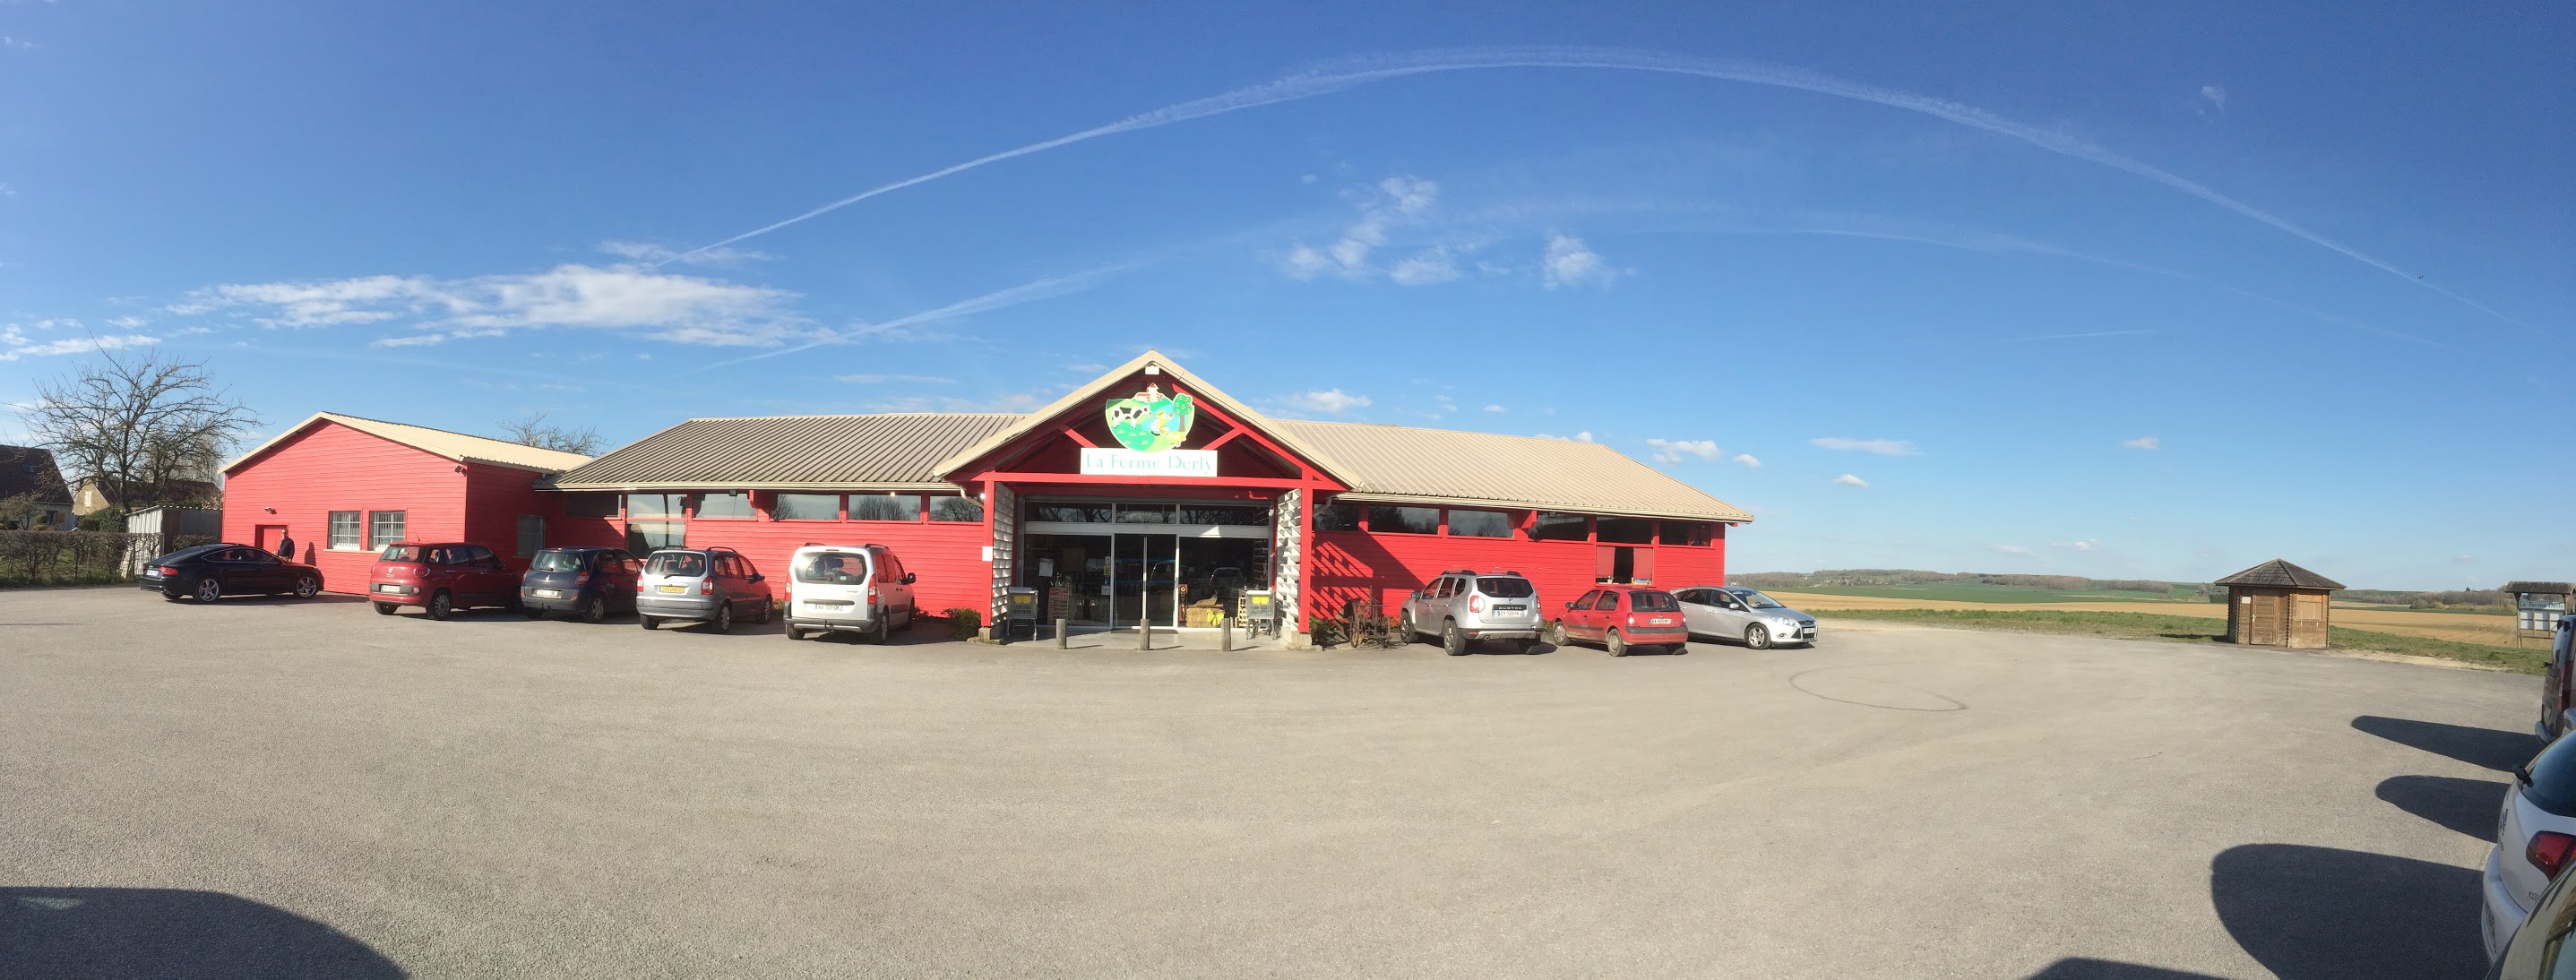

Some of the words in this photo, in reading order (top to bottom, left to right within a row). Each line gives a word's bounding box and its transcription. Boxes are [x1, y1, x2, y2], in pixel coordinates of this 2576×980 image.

[1086, 453, 1104, 469] La
[1111, 454, 1160, 469] Ferme
[1168, 455, 1211, 475] Derly
